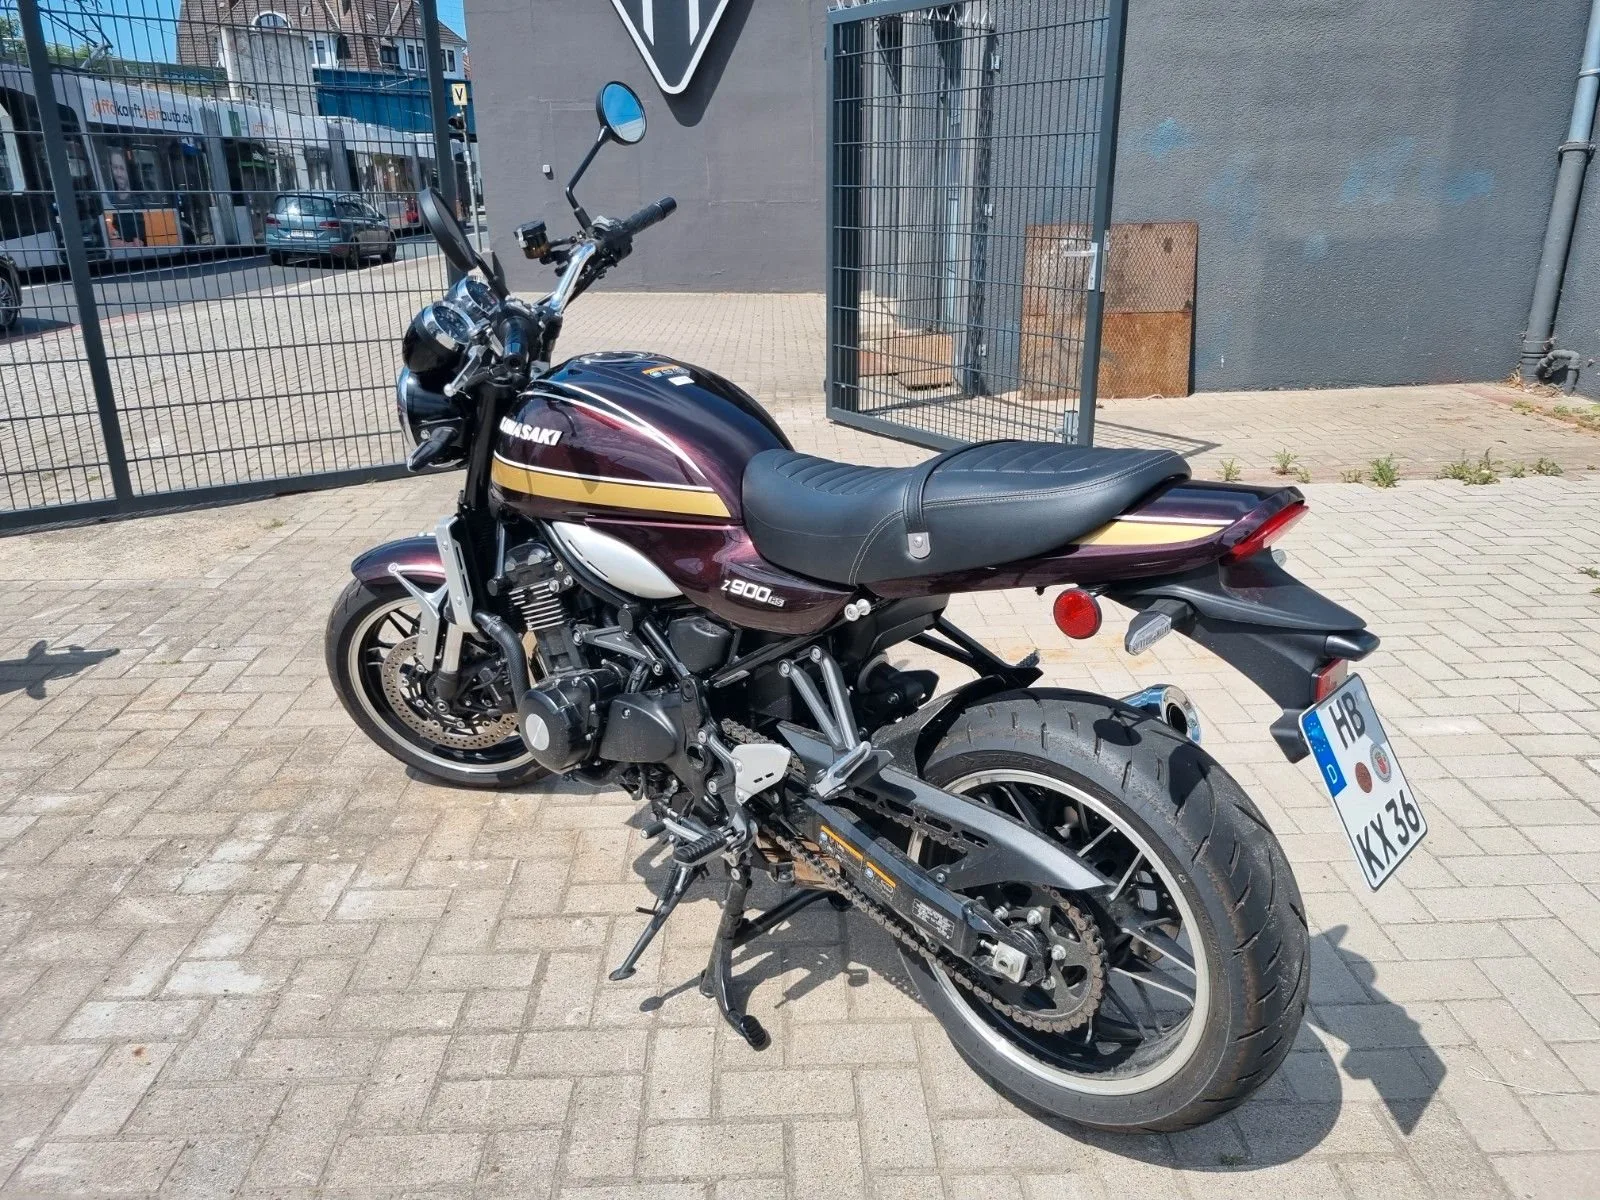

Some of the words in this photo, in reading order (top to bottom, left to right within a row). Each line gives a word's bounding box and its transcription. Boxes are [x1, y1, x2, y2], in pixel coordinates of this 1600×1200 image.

[454, 87, 464, 101] V
[1328, 691, 1366, 750] HB
[1326, 763, 1339, 785] D
